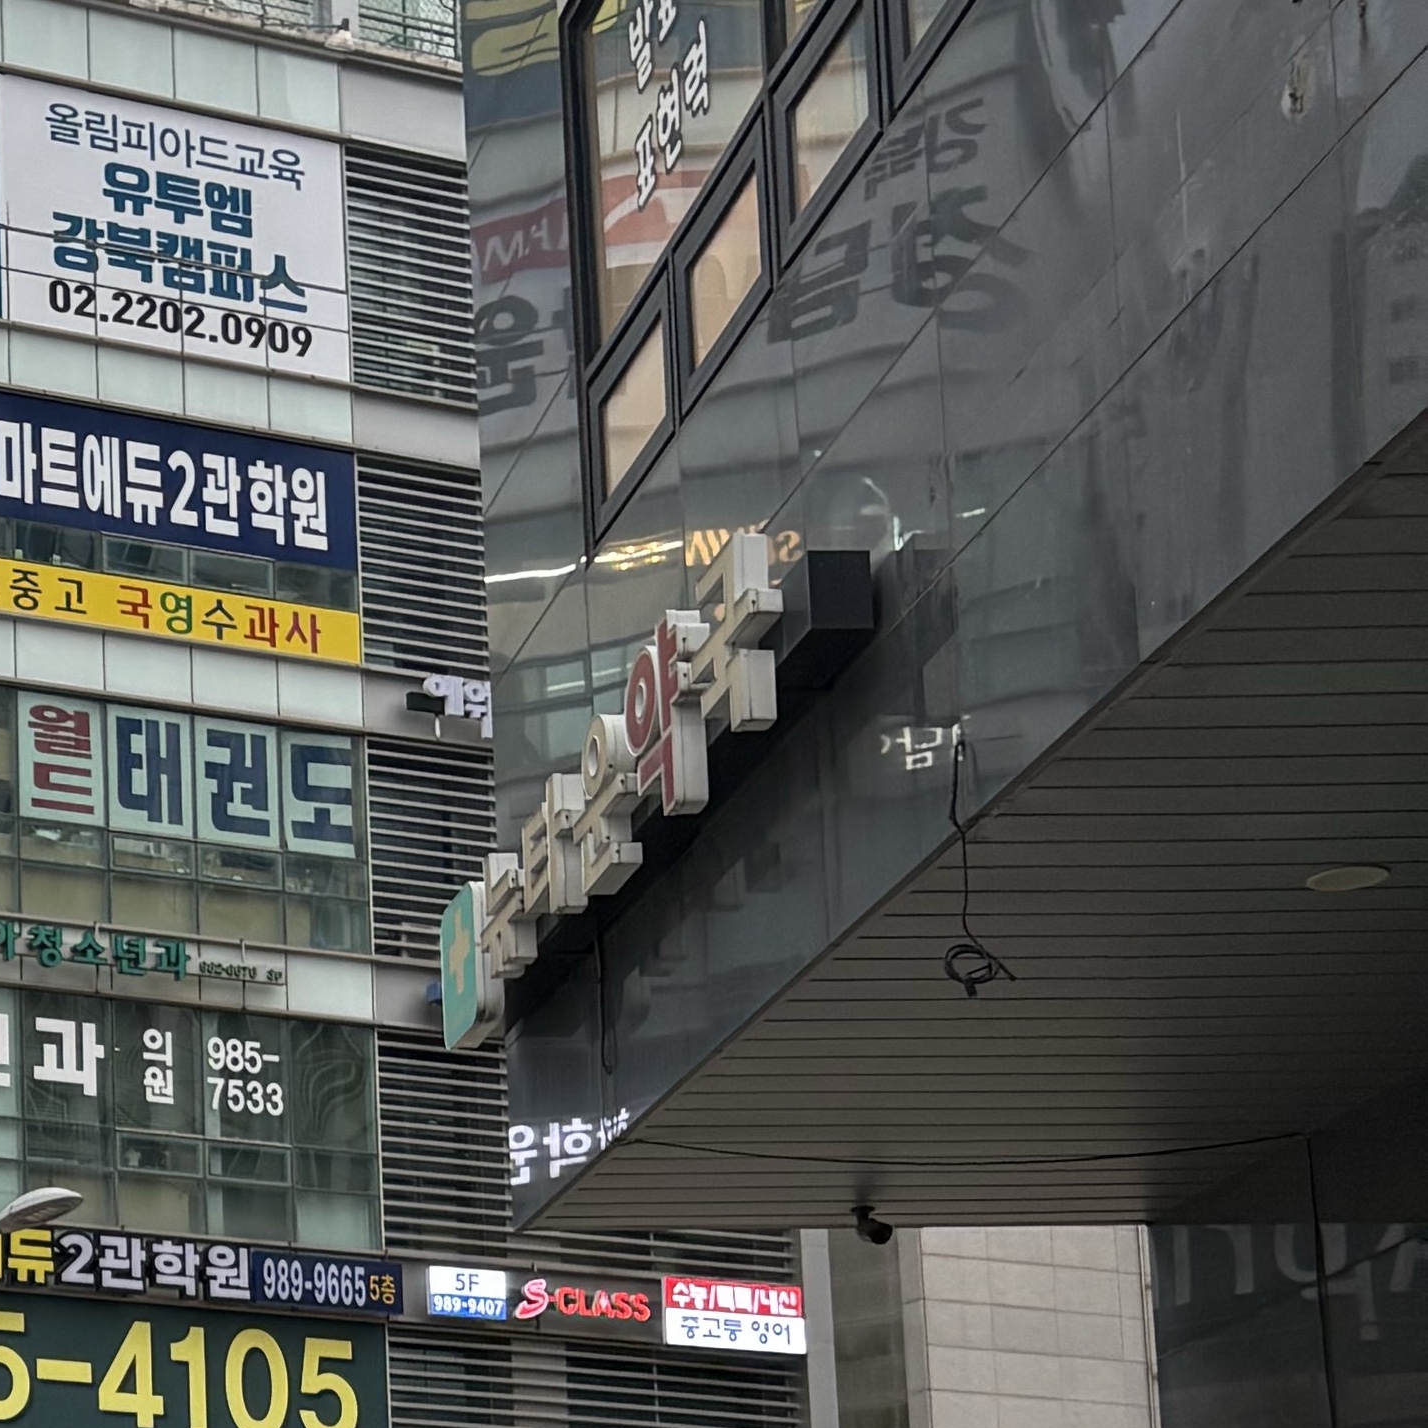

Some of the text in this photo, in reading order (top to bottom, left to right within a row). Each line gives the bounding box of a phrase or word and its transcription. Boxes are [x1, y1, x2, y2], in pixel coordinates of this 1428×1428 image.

[45, 102, 305, 191] 올림피아드교육
[103, 161, 254, 240] 유투엠
[51, 210, 309, 314] 강북캠퍼스
[48, 279, 313, 358] 02.2202.0909
[116, 583, 322, 654] 국영수과사
[114, 714, 354, 845] 태권도
[261, 1256, 368, 1308] 989-9665
[454, 1271, 480, 1293] 5F
[514, 1277, 652, 1322] S-CLASS
[680, 1315, 791, 1345] 중고등 영어
